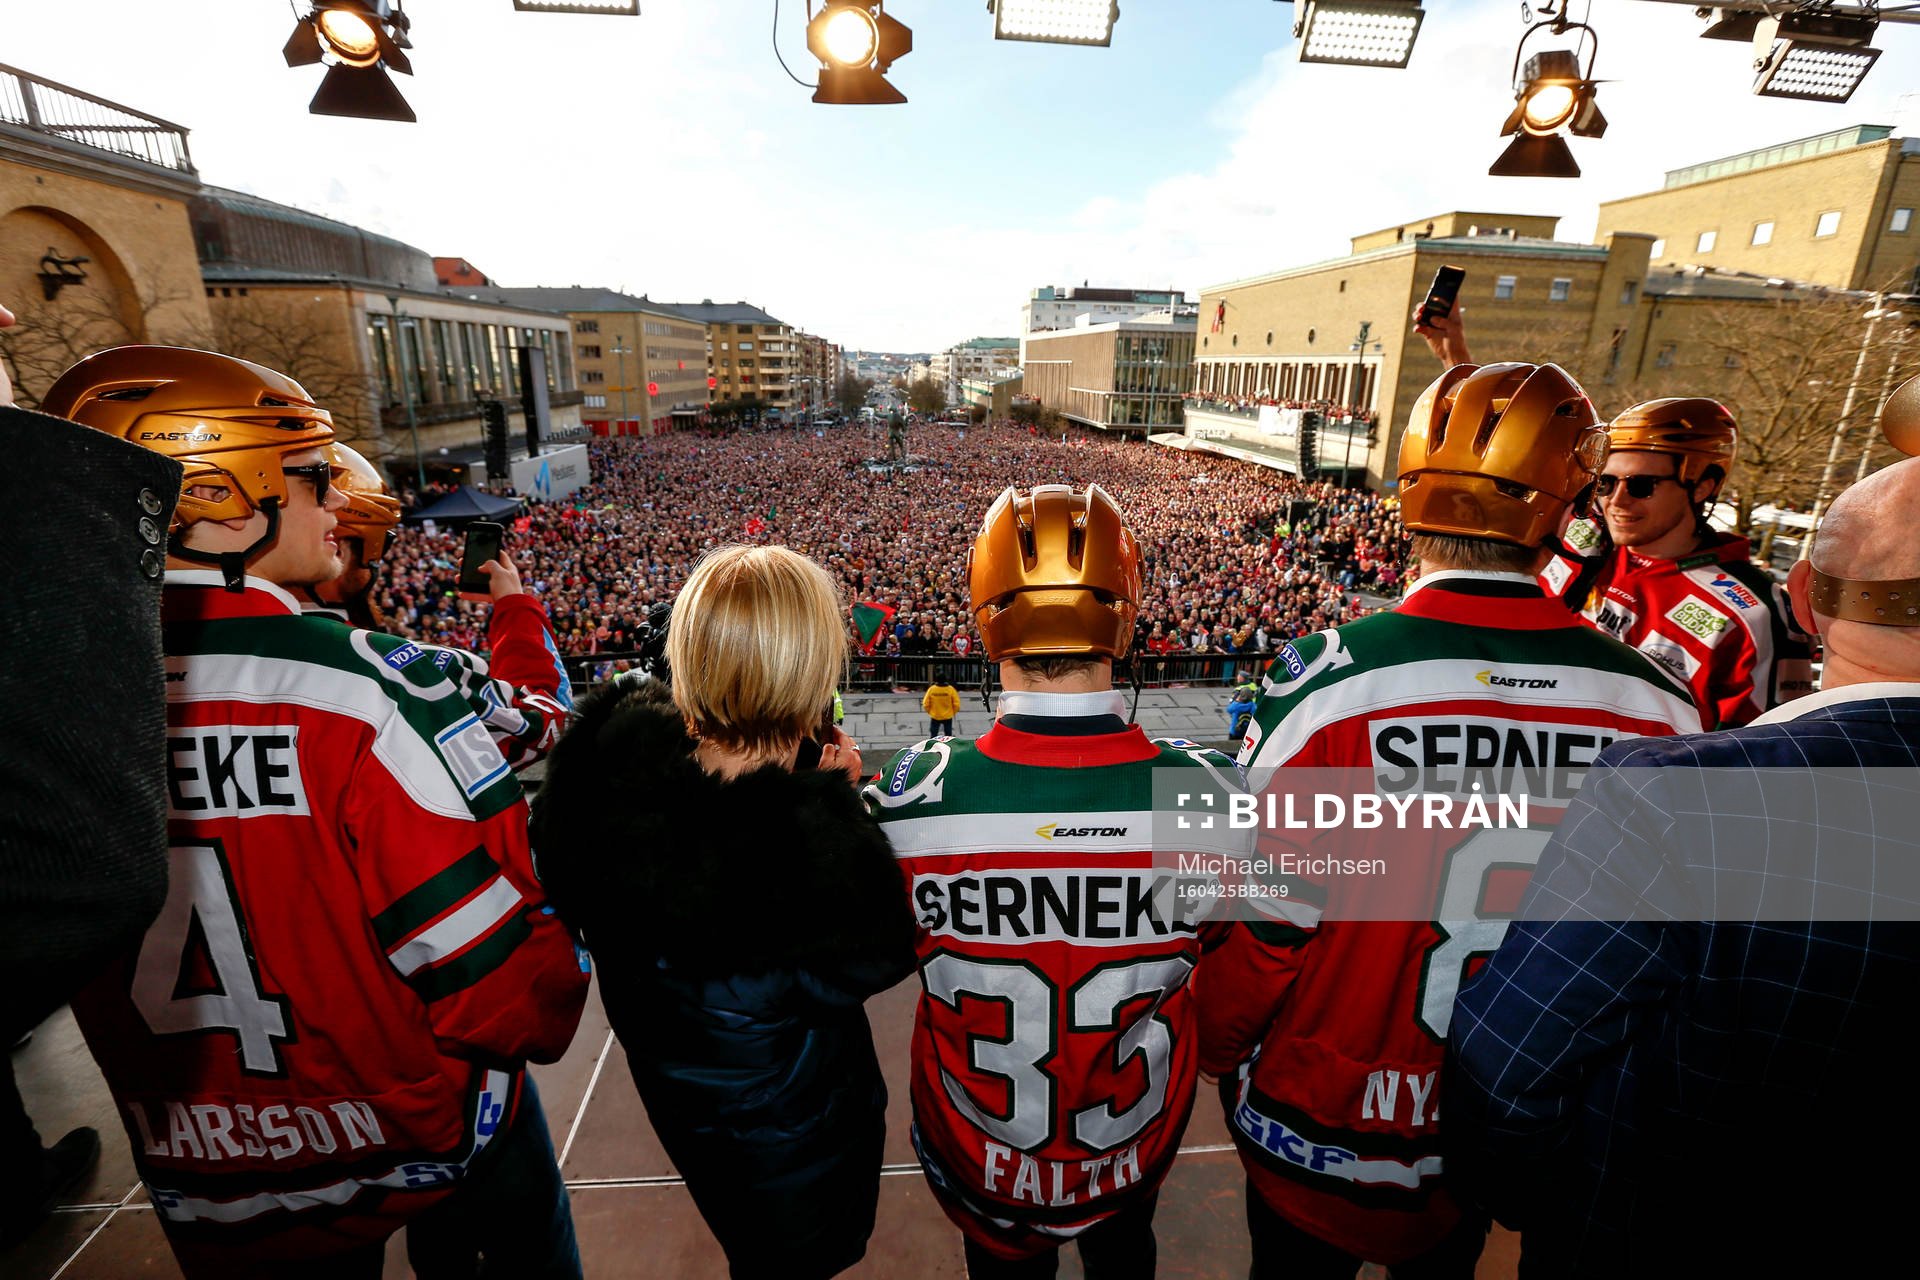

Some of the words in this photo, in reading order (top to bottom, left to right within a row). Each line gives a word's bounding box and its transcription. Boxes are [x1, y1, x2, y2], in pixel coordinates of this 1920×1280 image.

[140, 432, 222, 442] EASTON
[1723, 589, 1750, 610] SPORT
[1732, 584, 1759, 608] INTER
[1672, 609, 1713, 639] BUDDY
[1682, 602, 1713, 626] CASH
[1649, 649, 1685, 671] BOHUS
[1490, 675, 1558, 689] EASTON
[1374, 724, 1614, 801] SERNE
[1053, 827, 1128, 838] EASTON
[915, 875, 1209, 940] SERNEKE
[130, 840, 292, 1077] 4
[920, 949, 1197, 1155] 33
[1362, 1069, 1440, 1127] NY
[129, 1101, 386, 1161] LARSSON
[1234, 1101, 1358, 1172] SKF
